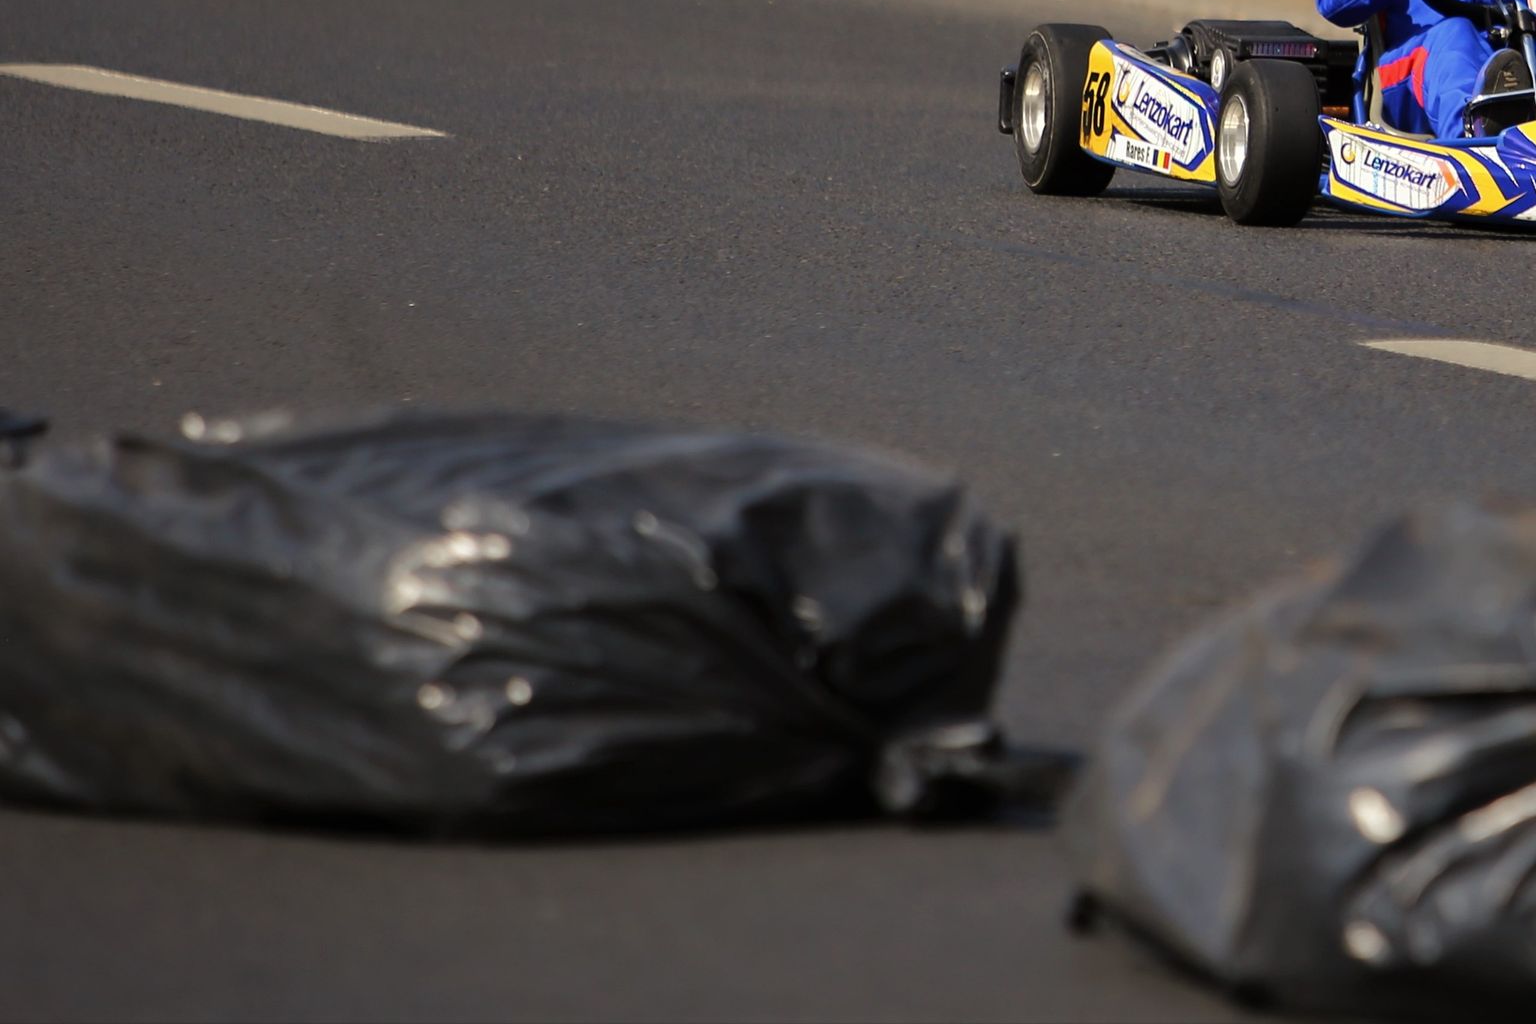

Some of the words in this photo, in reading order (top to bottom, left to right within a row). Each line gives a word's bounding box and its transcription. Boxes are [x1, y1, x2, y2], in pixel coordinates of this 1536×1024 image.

[1082, 72, 1111, 138] 58
[1133, 81, 1194, 146] Lenzokart
[1126, 140, 1145, 163] Rares
[1363, 150, 1437, 189] Lenzokart
